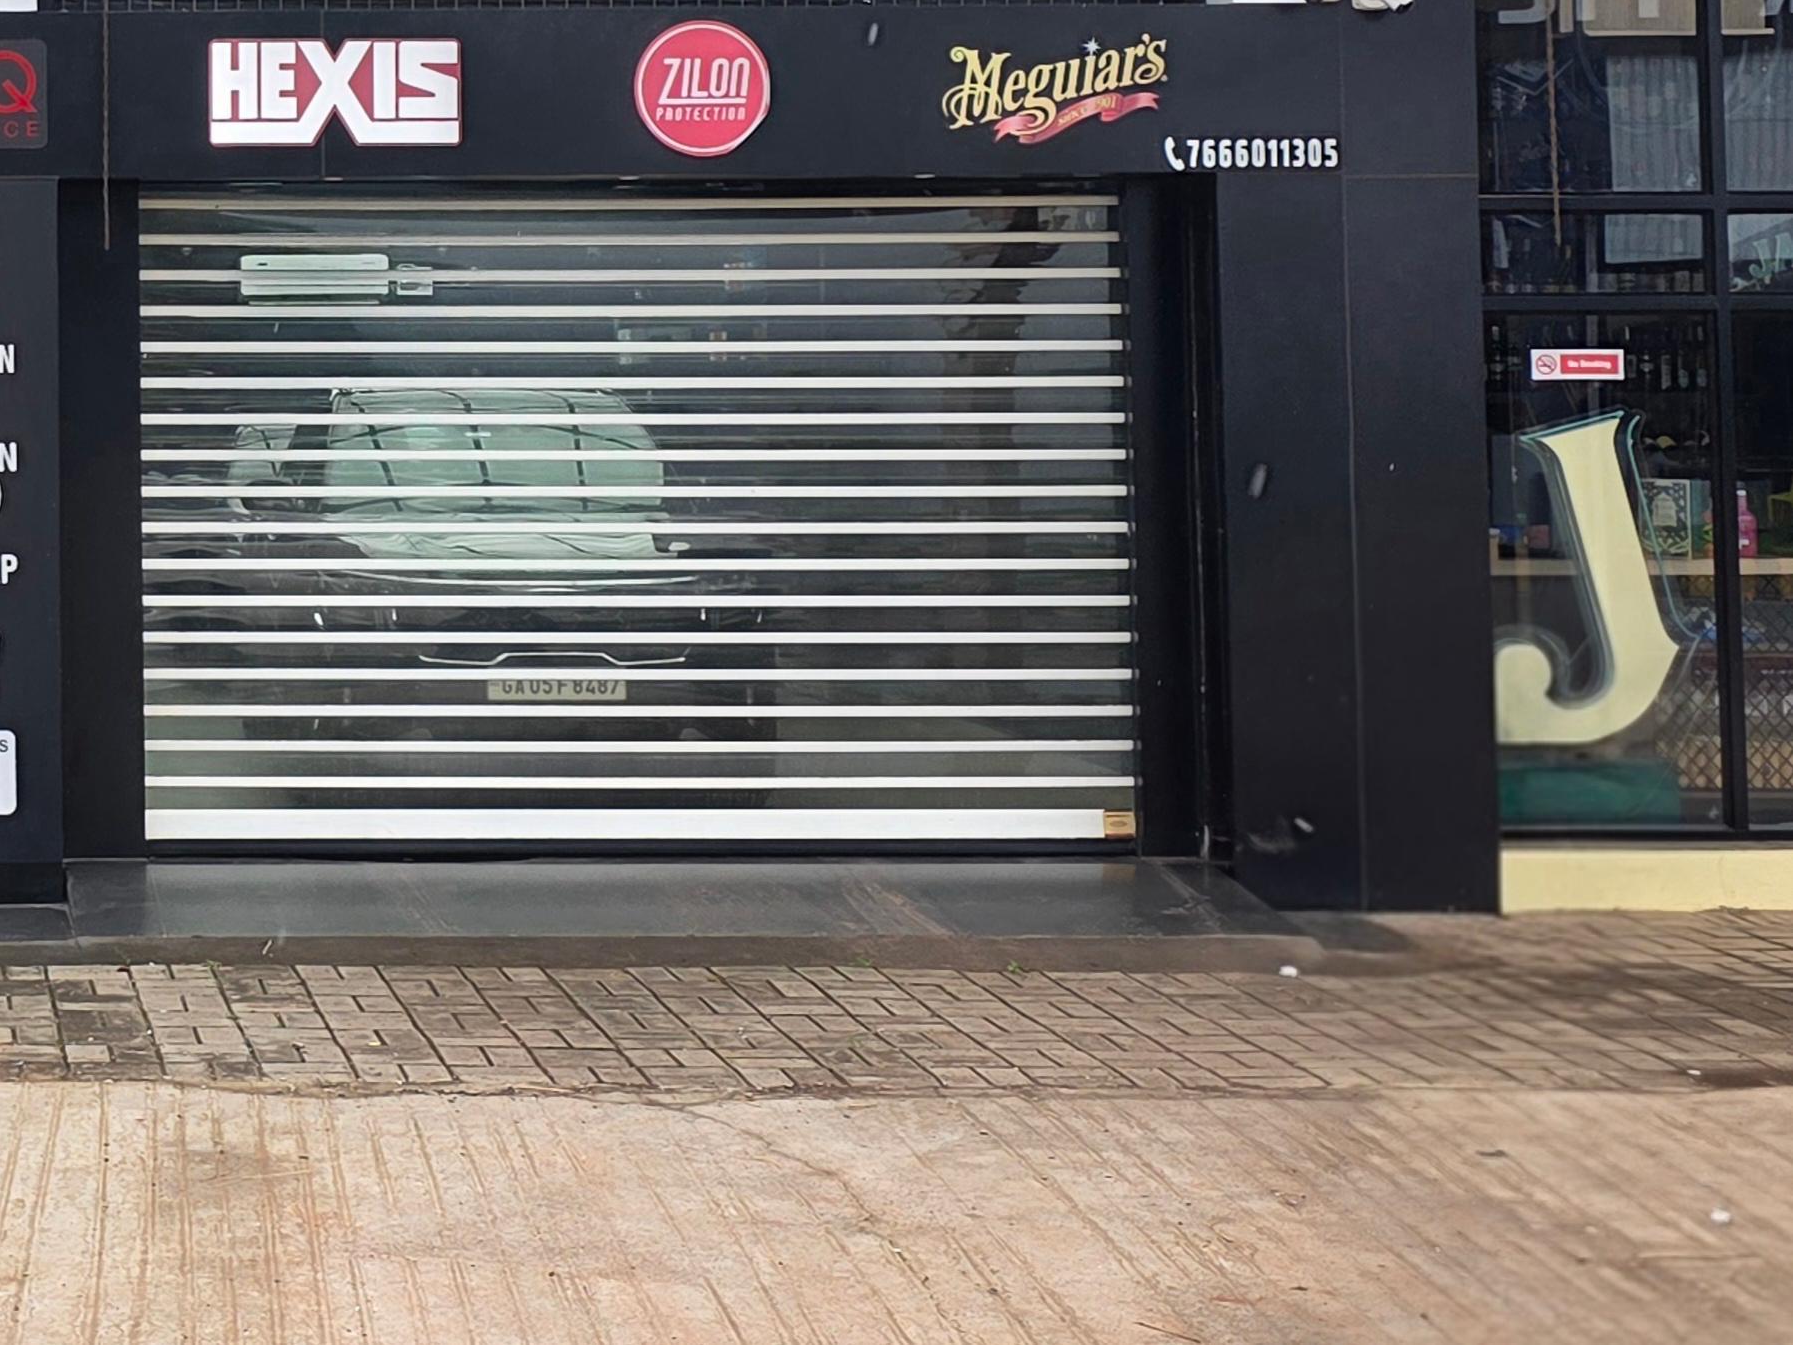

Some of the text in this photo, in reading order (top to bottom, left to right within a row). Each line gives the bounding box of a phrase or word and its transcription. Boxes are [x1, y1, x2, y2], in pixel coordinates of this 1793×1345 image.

[210, 39, 459, 144] HEXIS
[942, 33, 1168, 137] Meguiar's
[1186, 138, 1339, 169] 7666011305
